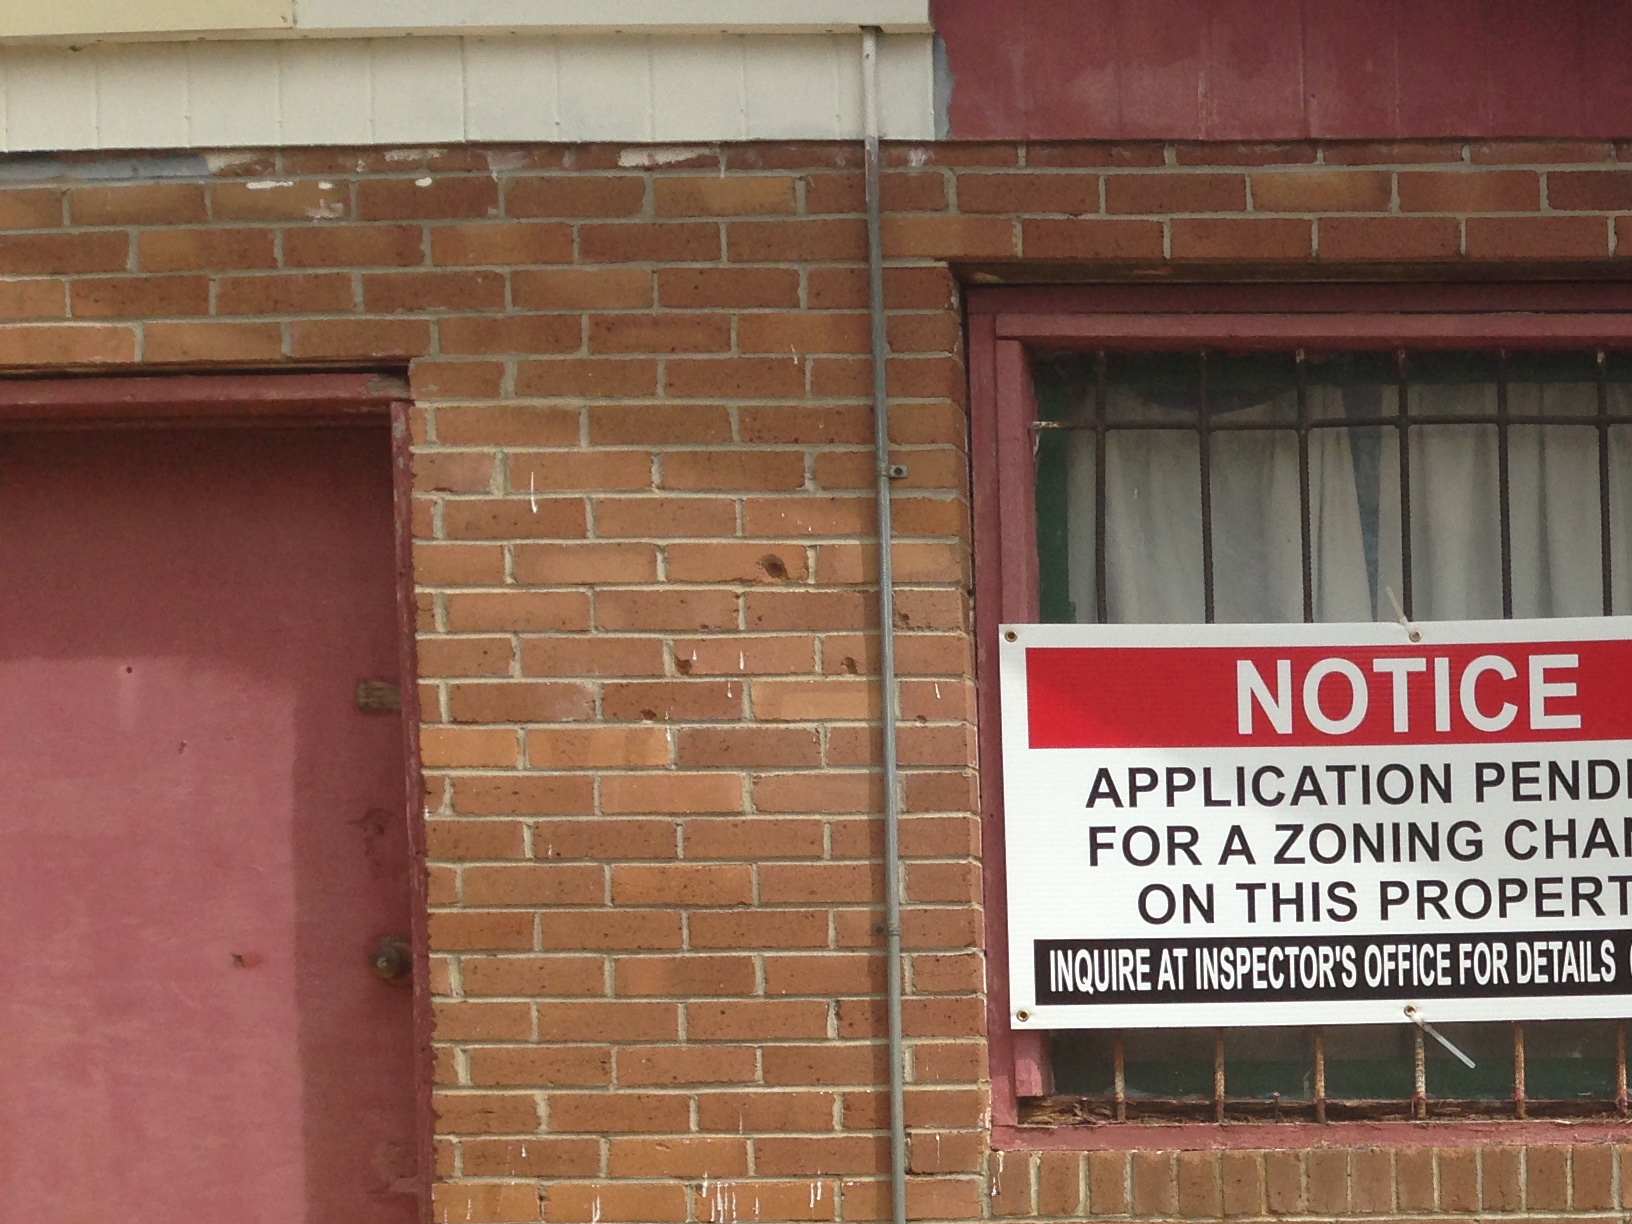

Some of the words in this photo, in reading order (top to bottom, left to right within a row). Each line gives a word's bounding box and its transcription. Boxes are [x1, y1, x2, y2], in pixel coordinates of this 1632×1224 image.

[1237, 654, 1581, 734] NOTICE
[1086, 763, 1451, 808] APPLICATION
[1090, 826, 1201, 866] FOR
[1219, 825, 1256, 865] A
[1274, 821, 1482, 864] ZONING
[1138, 884, 1214, 924] ON
[1236, 881, 1357, 923] THIS
[1050, 949, 1151, 994] INQUIRE
[1158, 948, 1188, 990] AT
[1196, 945, 1356, 990] INSPECTOR'S
[1365, 944, 1451, 987] OFFICE
[1459, 943, 1509, 985] FOR
[1516, 940, 1615, 983] DETAILS
